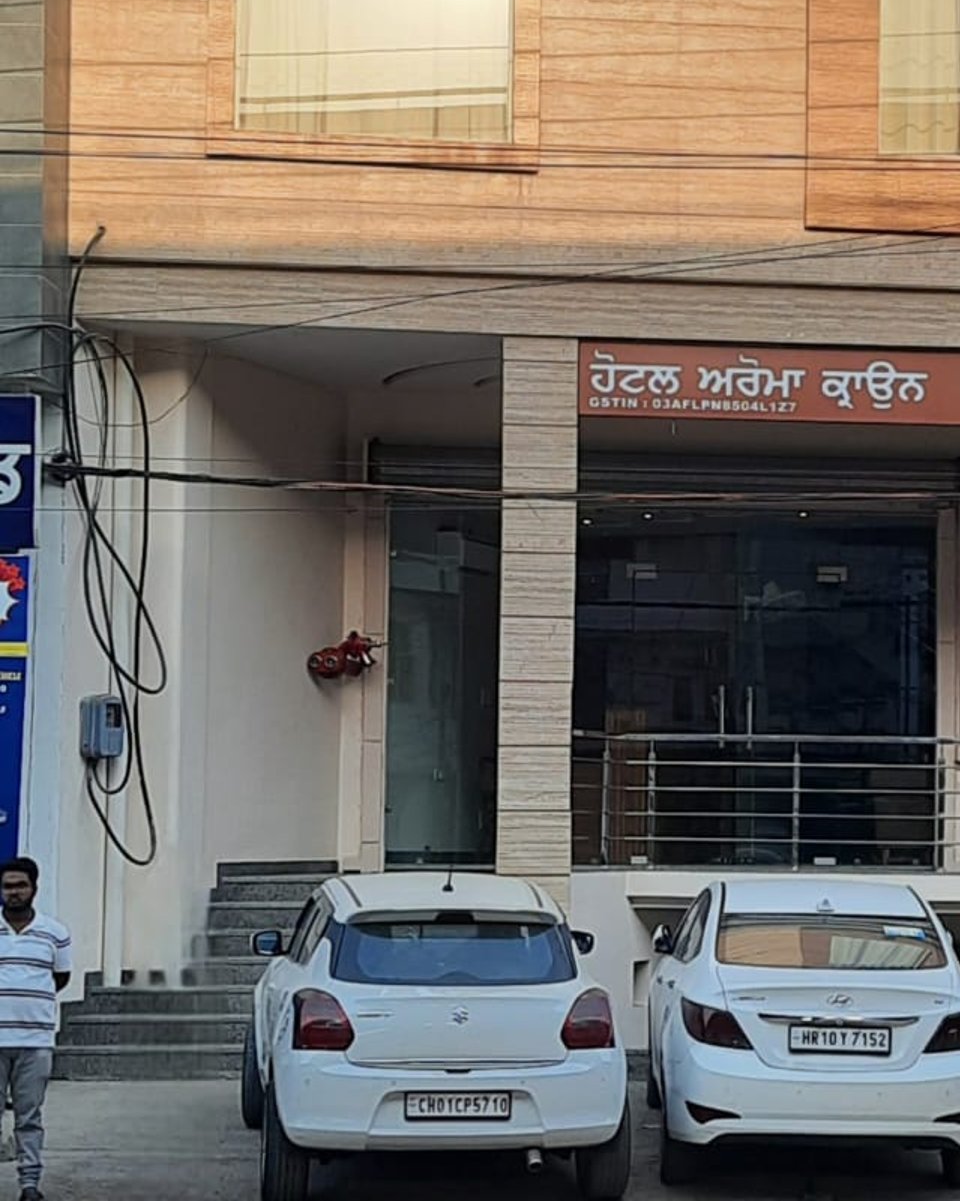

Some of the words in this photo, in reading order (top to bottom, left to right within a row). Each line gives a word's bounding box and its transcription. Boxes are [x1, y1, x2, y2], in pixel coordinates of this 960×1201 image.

[589, 350, 682, 394] ਹੋਟਲ
[698, 354, 805, 398] ਅਰੋਮਾ
[589, 397, 638, 408] GSTIN
[418, 1095, 508, 1113] CH01CP5710
